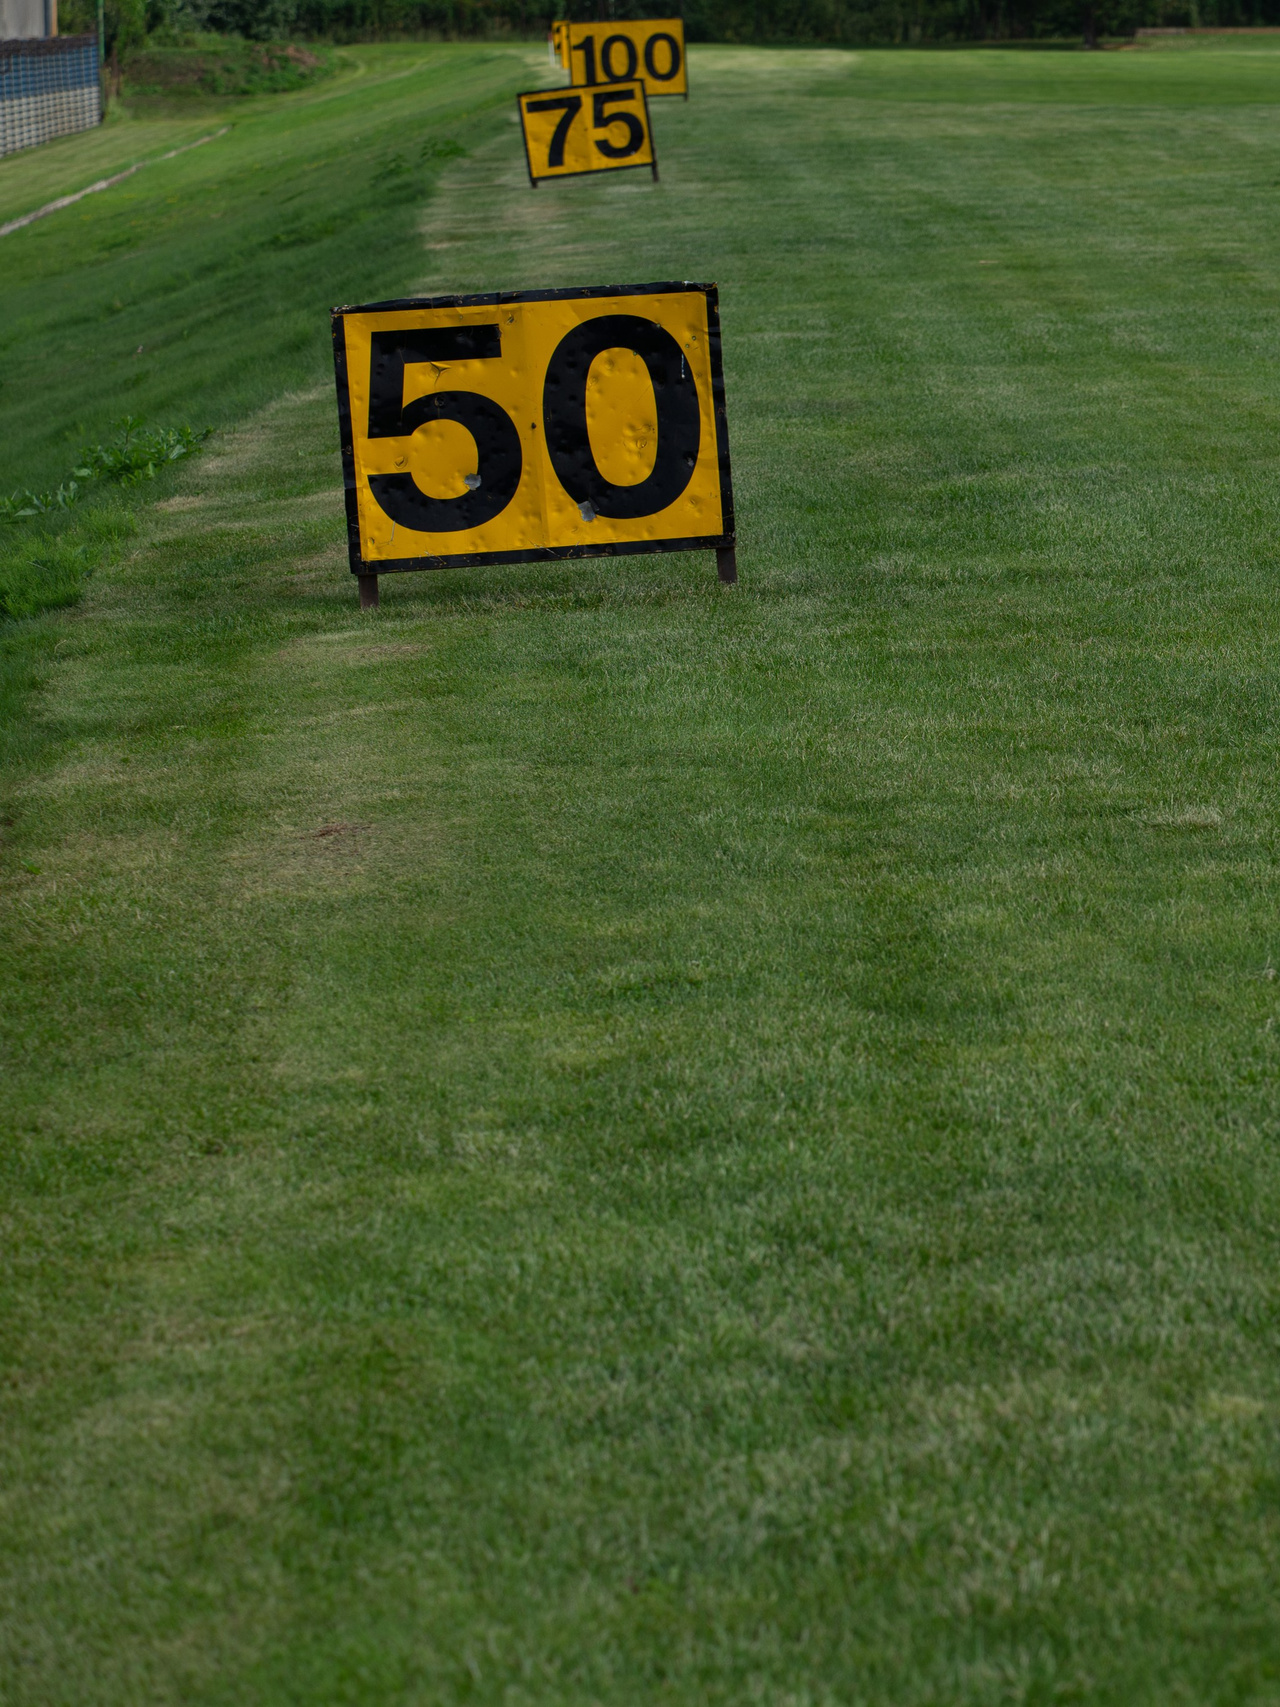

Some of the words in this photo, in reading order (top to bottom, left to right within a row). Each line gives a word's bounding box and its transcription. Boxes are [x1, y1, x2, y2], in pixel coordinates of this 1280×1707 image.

[573, 33, 680, 84] 100
[526, 89, 644, 168] 75
[367, 314, 700, 532] 50
